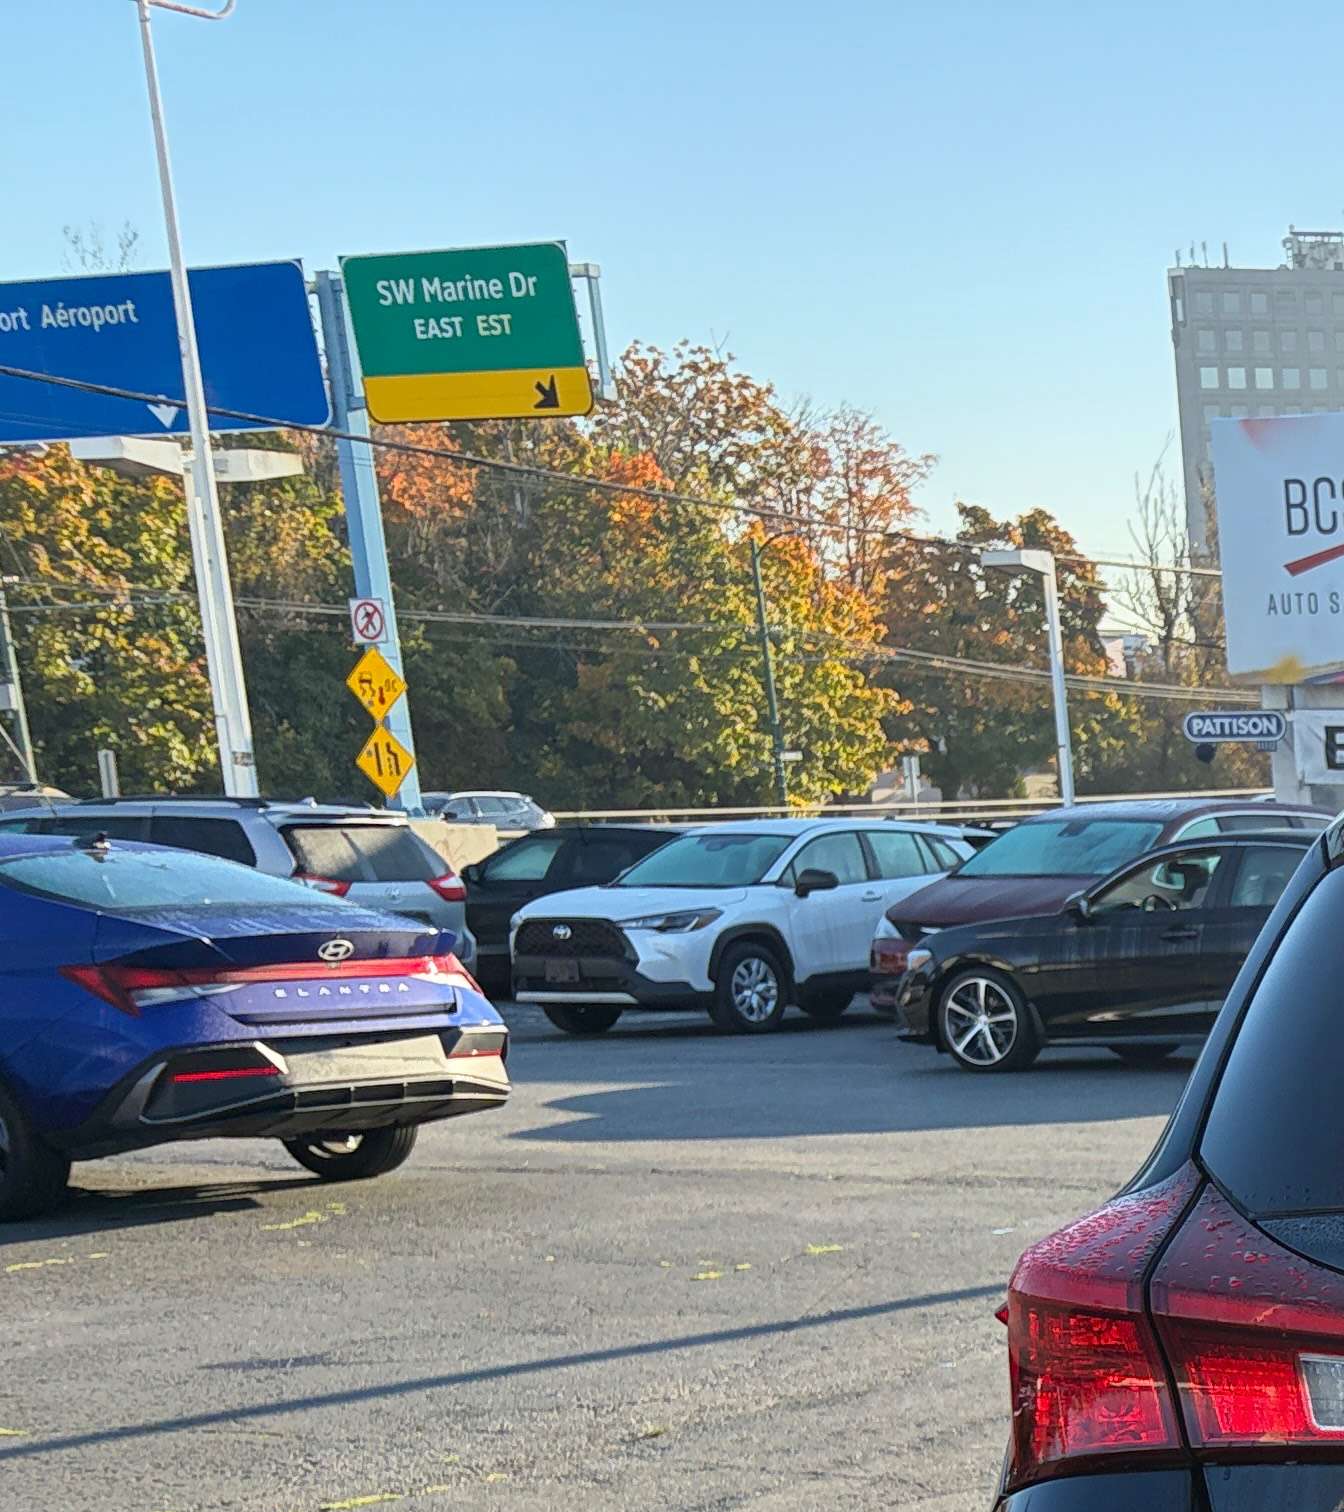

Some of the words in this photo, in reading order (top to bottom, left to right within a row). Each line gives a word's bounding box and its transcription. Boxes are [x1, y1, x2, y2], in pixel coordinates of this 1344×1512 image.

[376, 279, 415, 306] SW
[421, 274, 504, 302] Marine
[508, 272, 537, 298] Dr
[41, 300, 139, 332] Aéroport
[413, 316, 464, 339] EAST
[476, 314, 512, 336] EST
[1267, 592, 1319, 616] AUTO
[1192, 714, 1279, 737] PATTISON
